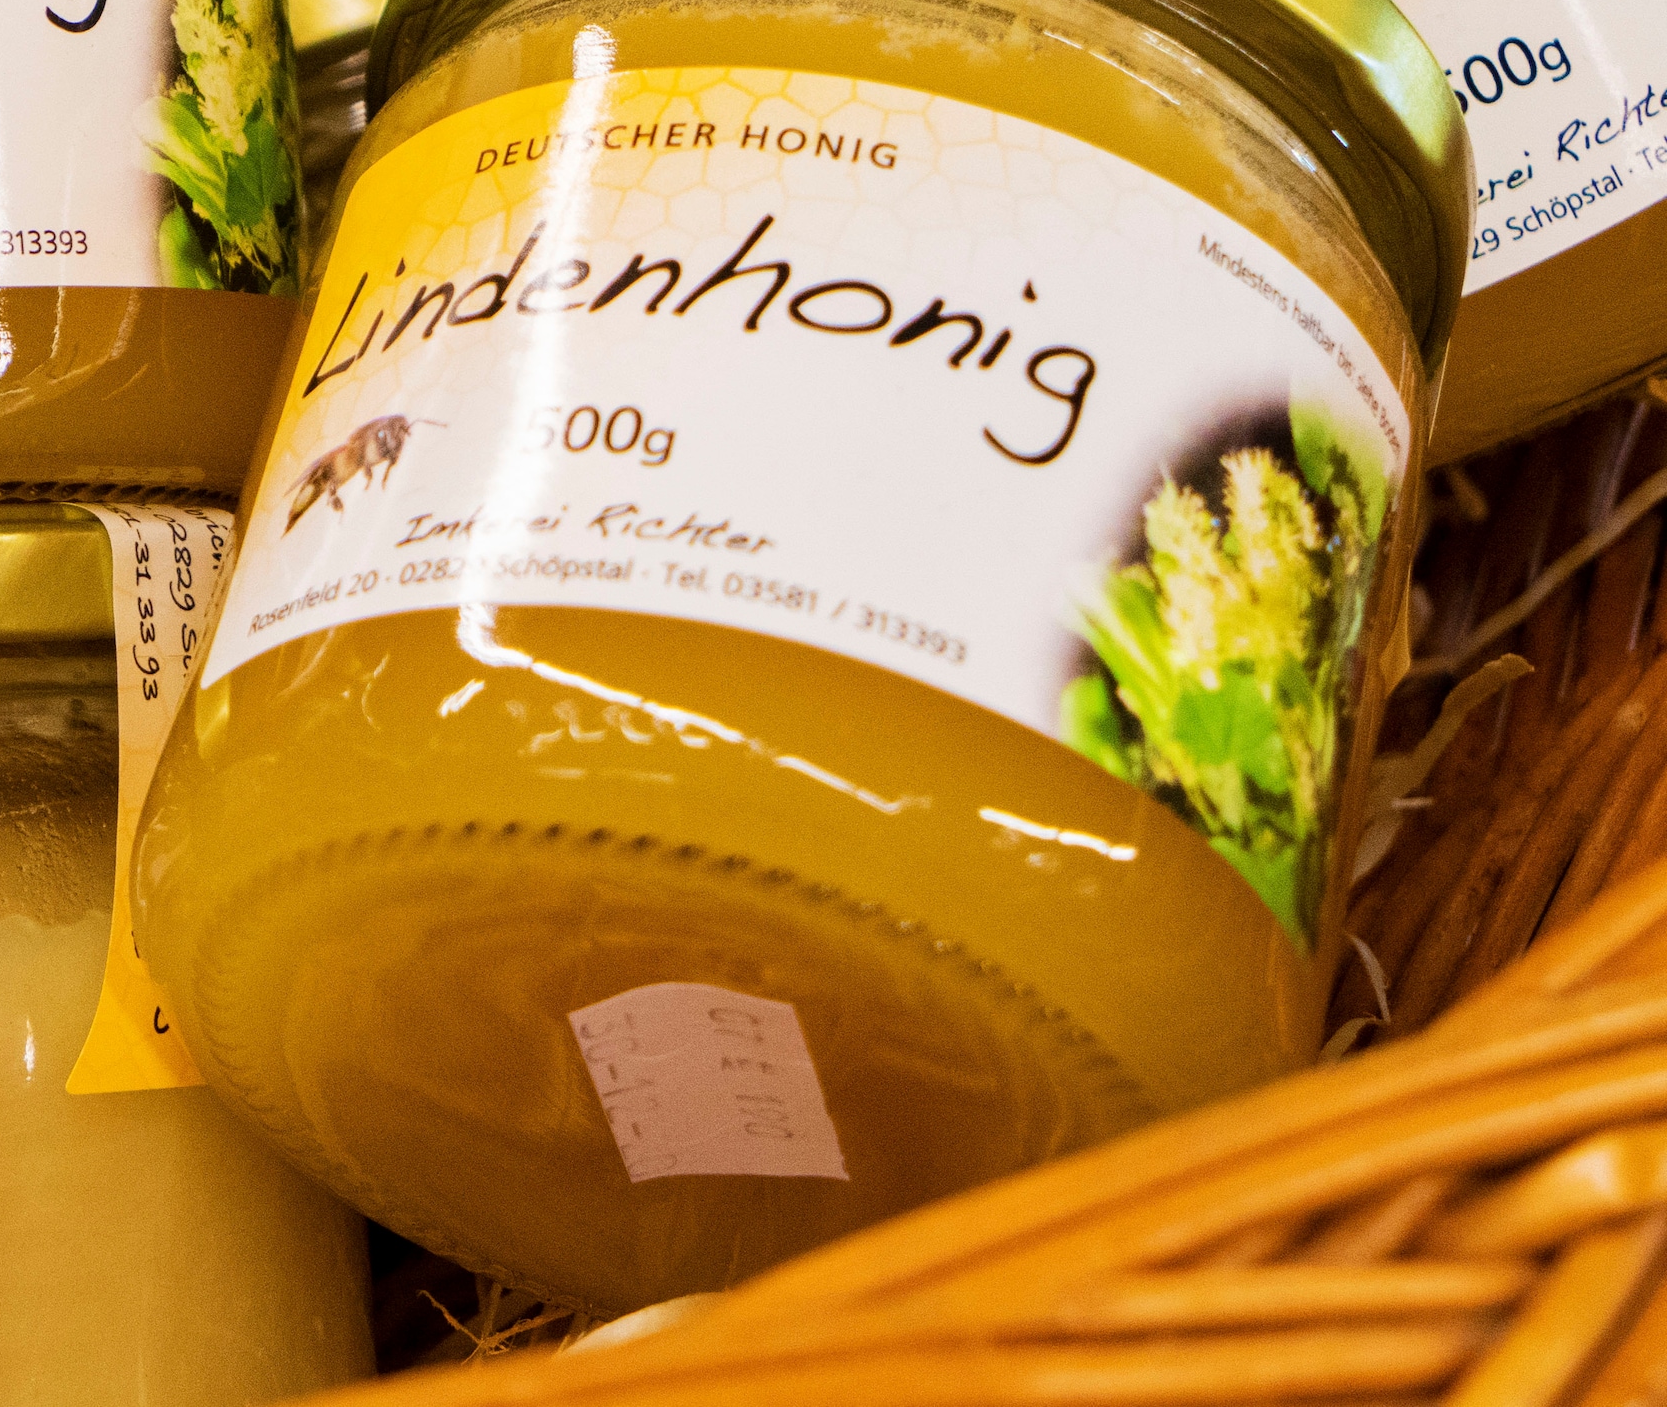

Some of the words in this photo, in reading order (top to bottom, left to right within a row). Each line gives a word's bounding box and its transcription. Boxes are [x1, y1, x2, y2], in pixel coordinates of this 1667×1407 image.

[475, 121, 718, 175] DEUTSCHER
[741, 122, 900, 172] HONIG
[1506, 165, 1623, 240] Schöpstal
[0, 229, 89, 257] 313393
[1198, 234, 1288, 313] Mindestens
[301, 214, 1098, 465] Lindenhonig
[394, 504, 569, 548] Imkei
[585, 502, 778, 554] Richter
[247, 581, 342, 638] Rosenfeld
[346, 570, 379, 596] 20
[398, 555, 473, 587] 0282
